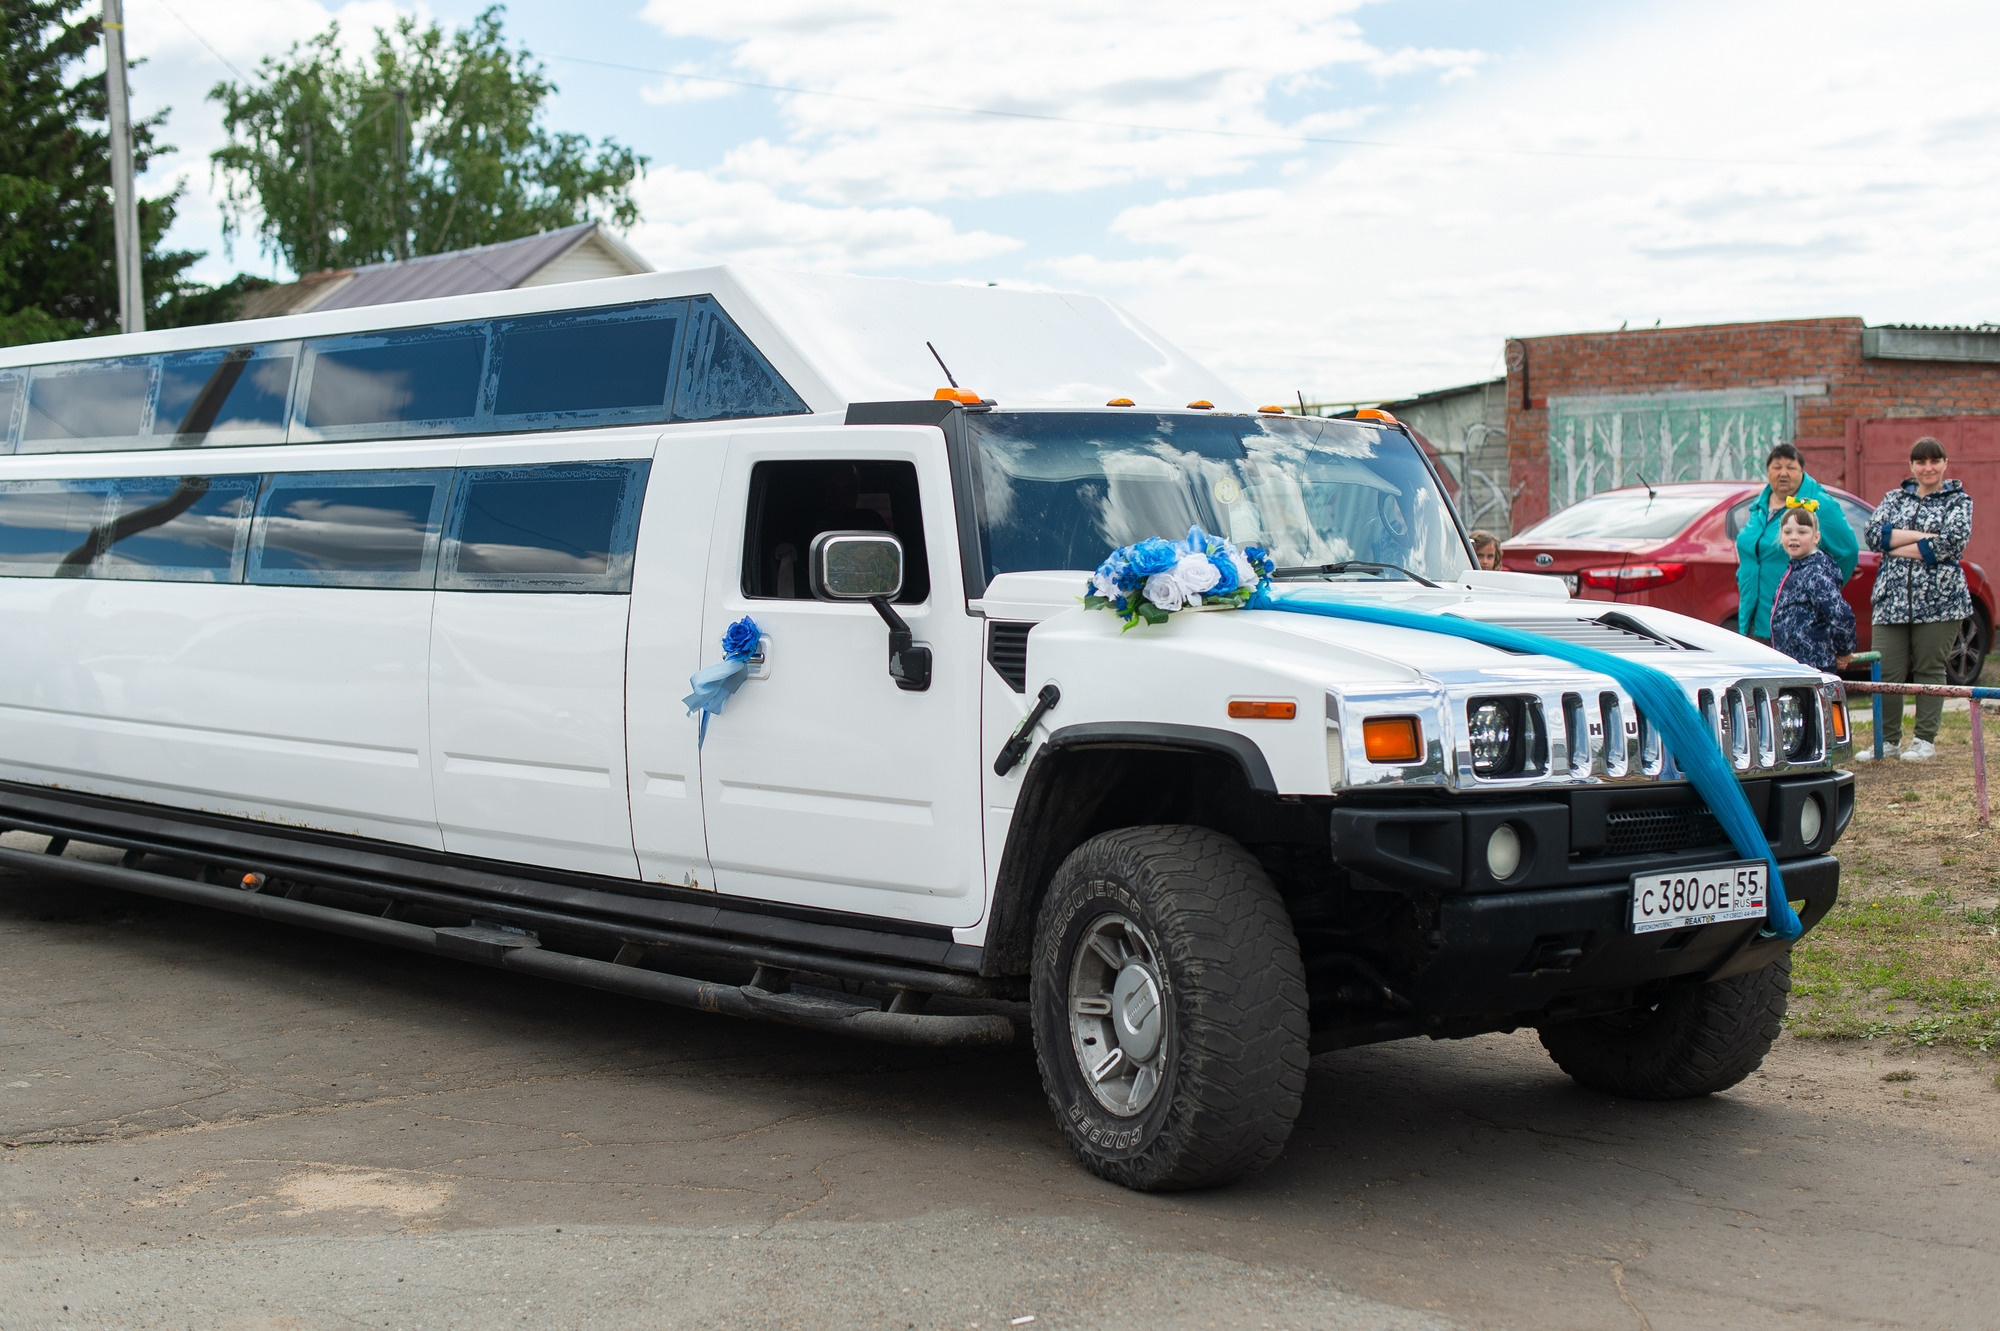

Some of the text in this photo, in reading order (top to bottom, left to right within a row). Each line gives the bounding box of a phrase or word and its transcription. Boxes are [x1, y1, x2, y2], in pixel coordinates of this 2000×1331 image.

[1737, 871, 1758, 897] 55
[1734, 899, 1751, 908] RUS
[1046, 880, 1141, 966] DISCOVERER
[1068, 1102, 1143, 1150] COOPER
